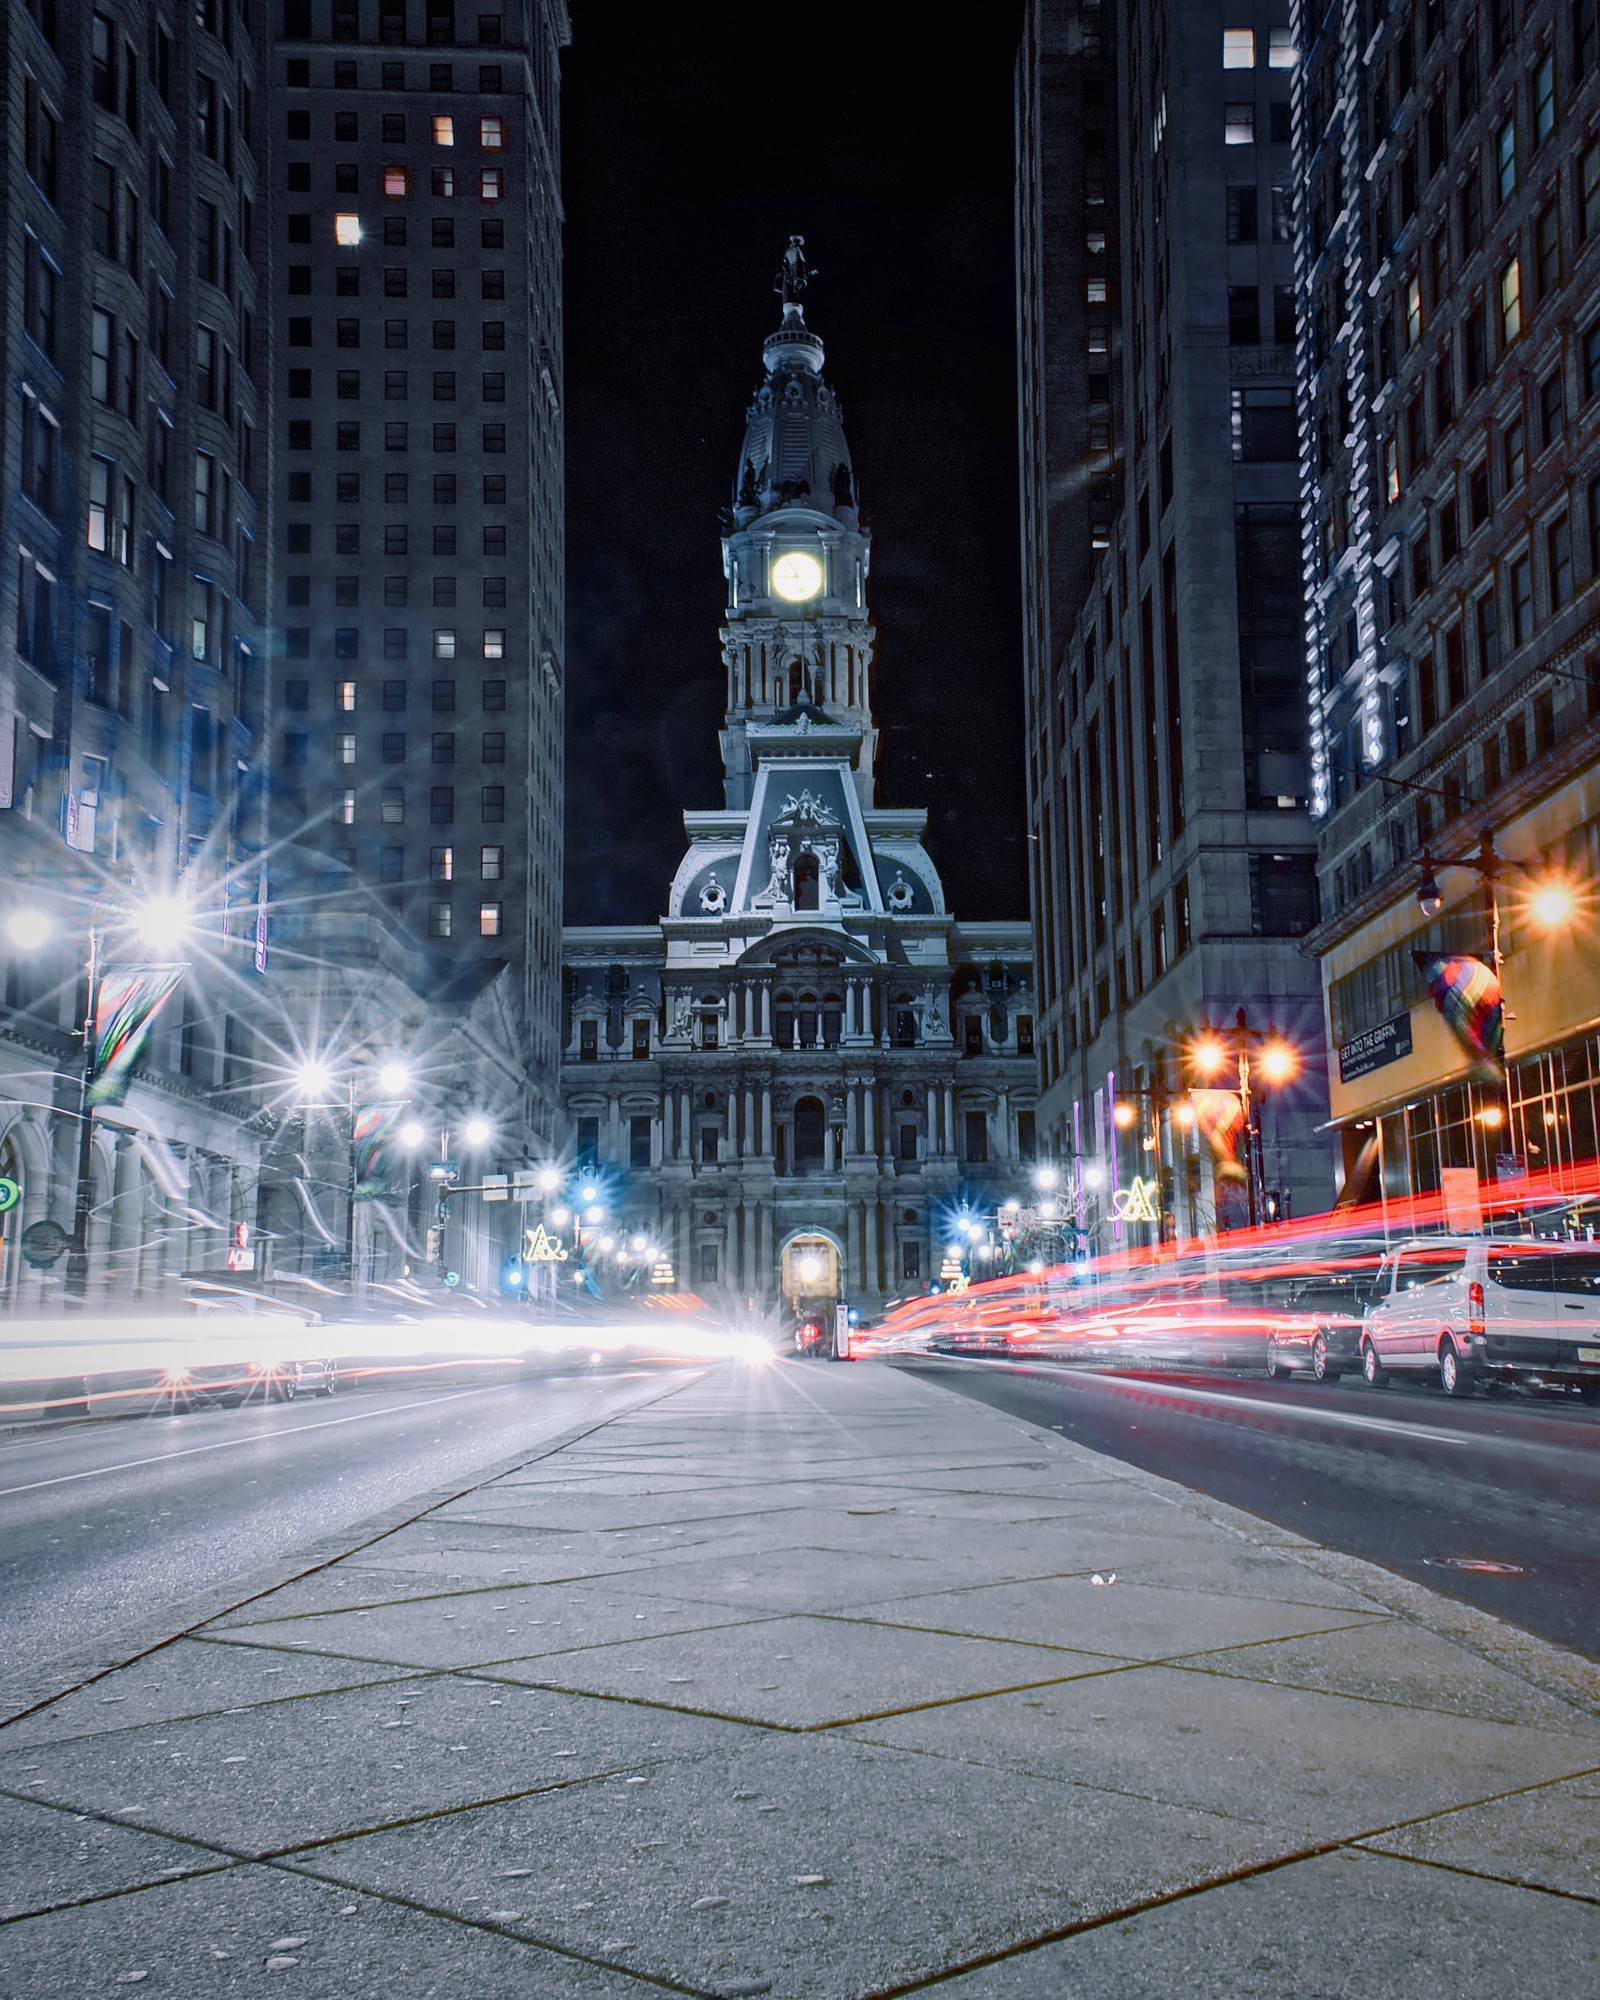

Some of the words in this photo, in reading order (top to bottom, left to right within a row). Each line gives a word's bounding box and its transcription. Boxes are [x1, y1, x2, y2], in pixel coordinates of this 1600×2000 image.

[1341, 1045, 1350, 1060] GET
[1350, 1039, 1364, 1056] INTO
[1363, 1033, 1374, 1049] THE
[1373, 1022, 1397, 1044] GRIFFIN
